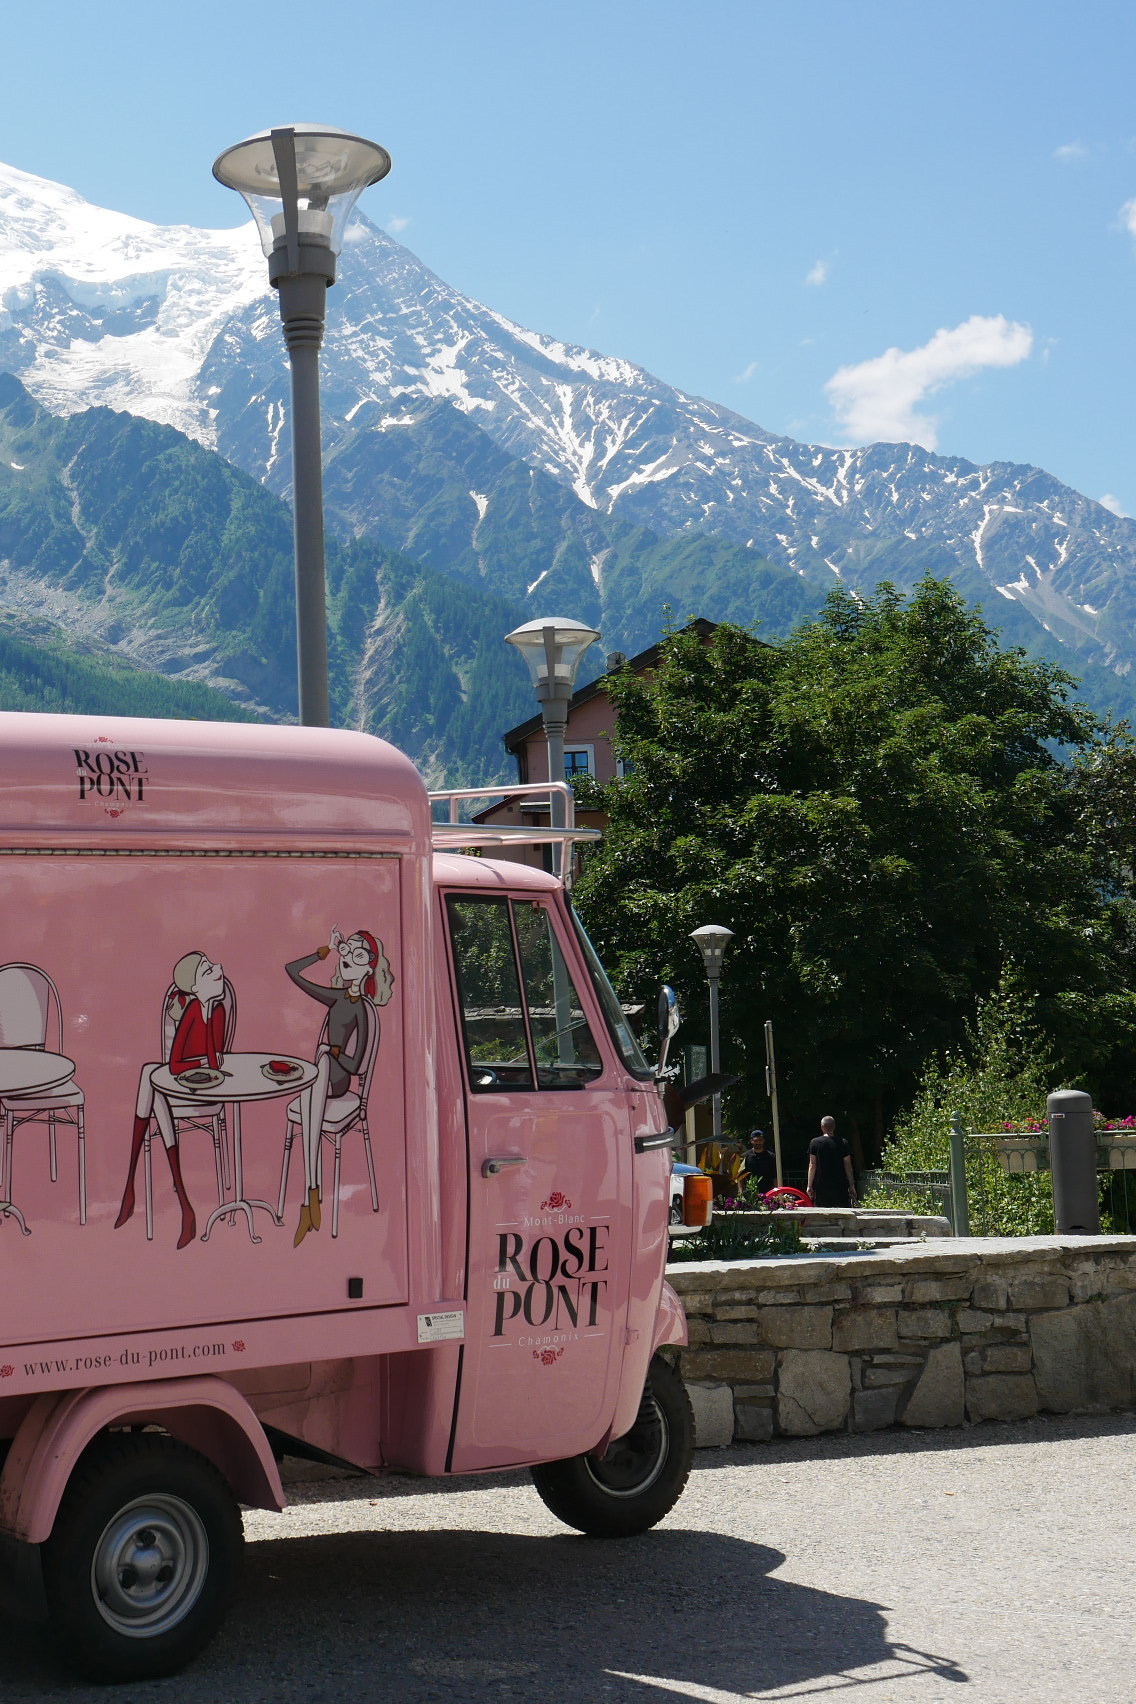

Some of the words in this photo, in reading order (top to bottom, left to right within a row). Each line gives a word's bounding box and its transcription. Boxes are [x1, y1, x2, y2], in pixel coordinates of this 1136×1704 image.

[72, 749, 148, 775] ROSE
[77, 773, 150, 801] PONT
[524, 1214, 586, 1227] Mont-Blanc
[494, 1226, 610, 1284] ROSE
[493, 1275, 510, 1289] du
[489, 1278, 608, 1337] PONT
[518, 1332, 579, 1347] Chamonix
[23, 1343, 226, 1376] www.rose-du-pont.com
